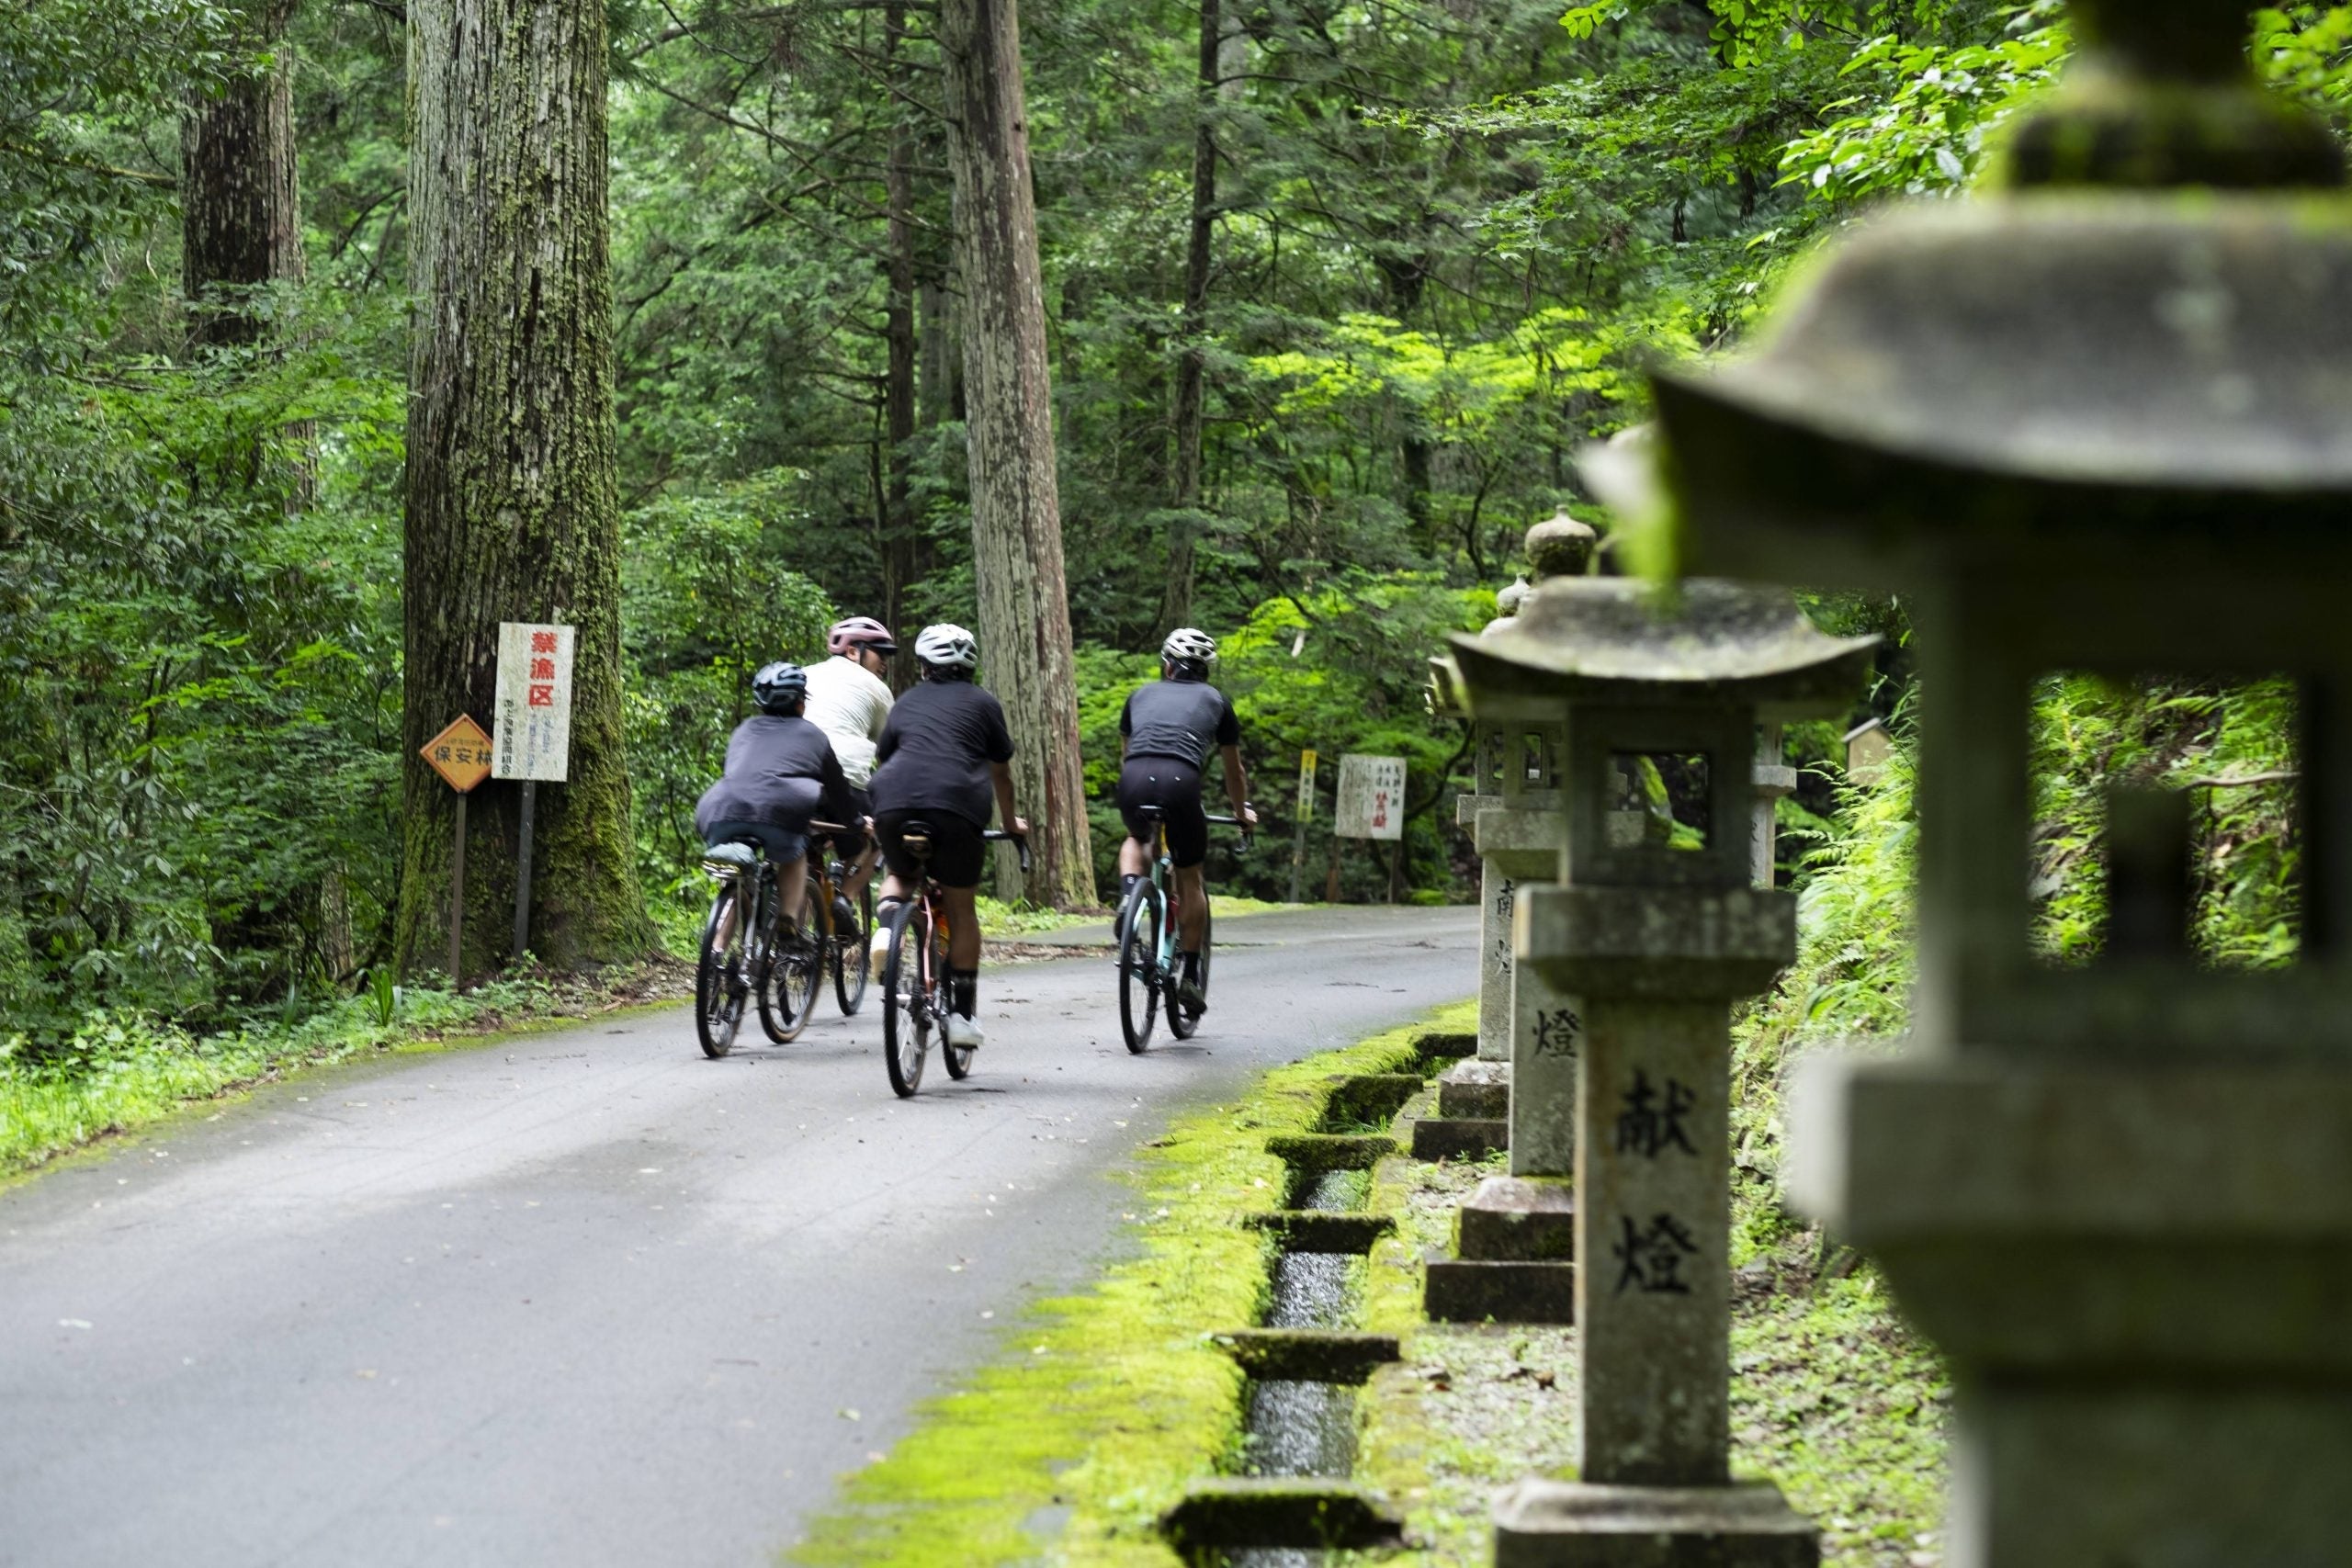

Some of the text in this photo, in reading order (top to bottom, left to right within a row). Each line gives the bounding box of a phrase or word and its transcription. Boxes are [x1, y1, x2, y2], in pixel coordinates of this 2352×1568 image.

[528, 631, 558, 706] 禁漁区
[435, 745, 492, 766] 保安林
[1532, 1009, 1581, 1057] 燈
[1613, 1069, 1699, 1298] 献燈
